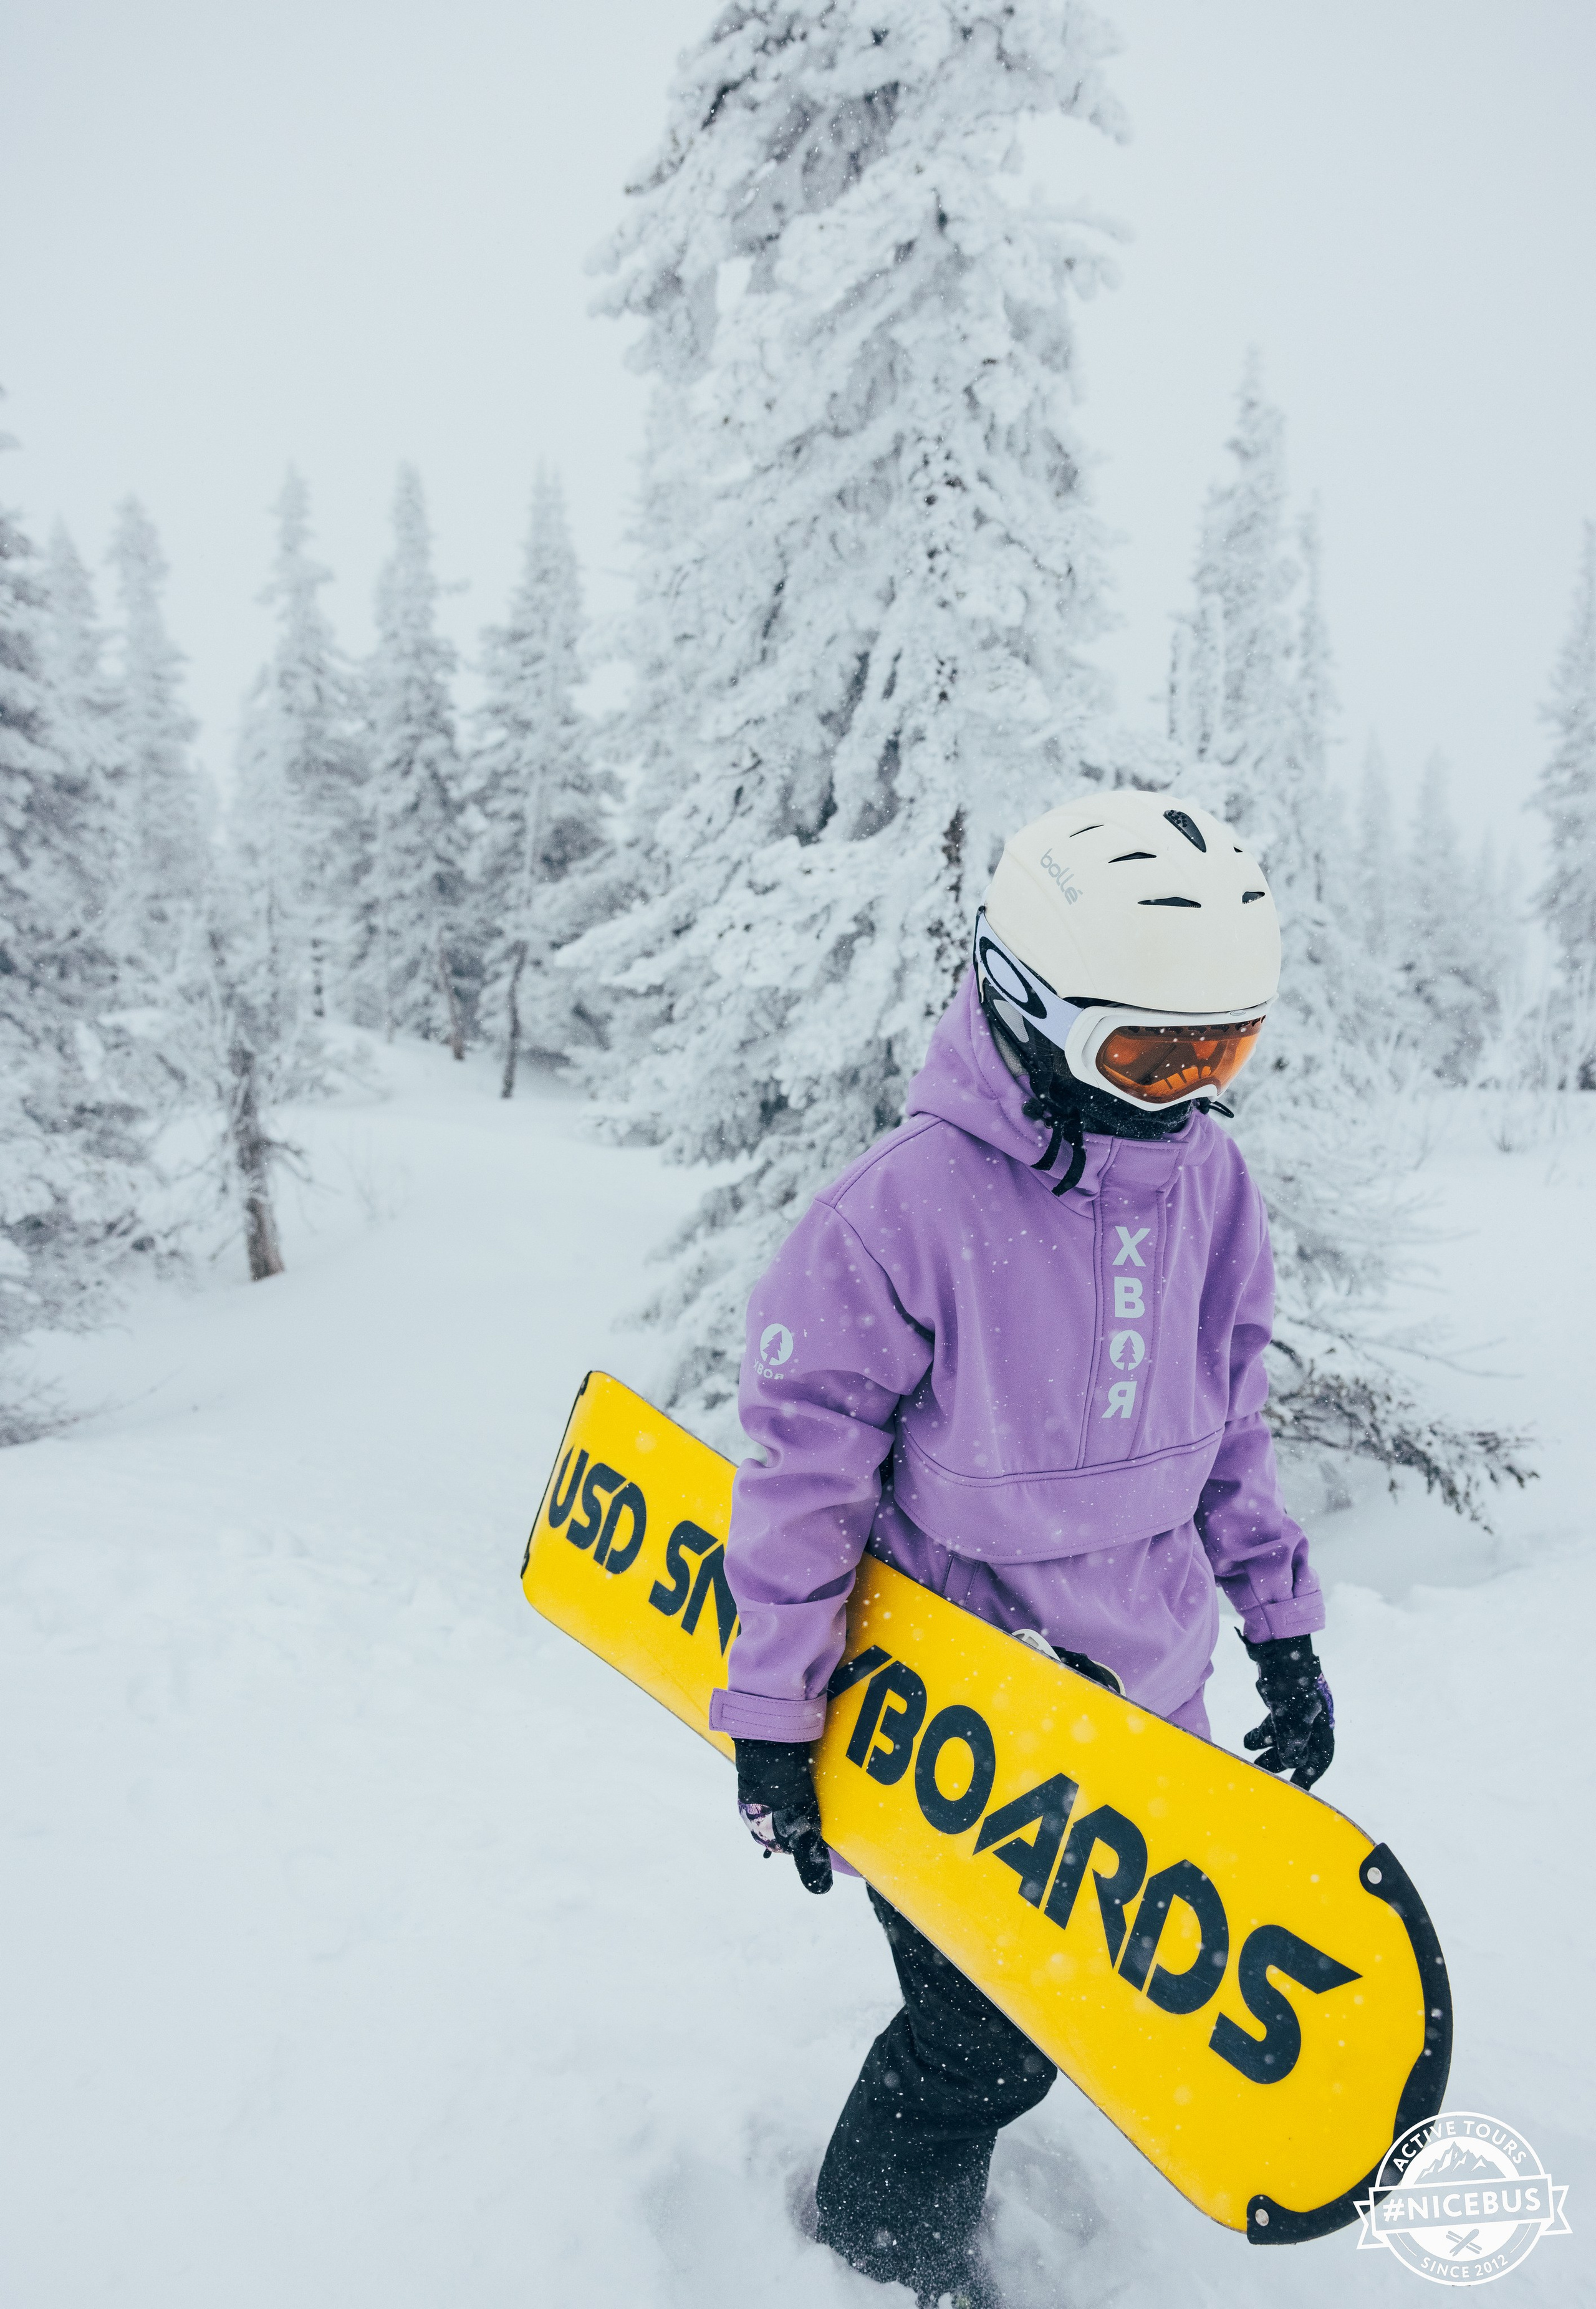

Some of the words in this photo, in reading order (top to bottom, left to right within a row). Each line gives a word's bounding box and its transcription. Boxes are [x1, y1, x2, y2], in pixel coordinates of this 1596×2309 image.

[1040, 847, 1084, 905] bollé
[548, 1444, 647, 1575] USD
[648, 1520, 1364, 2085] SNBOARDS
